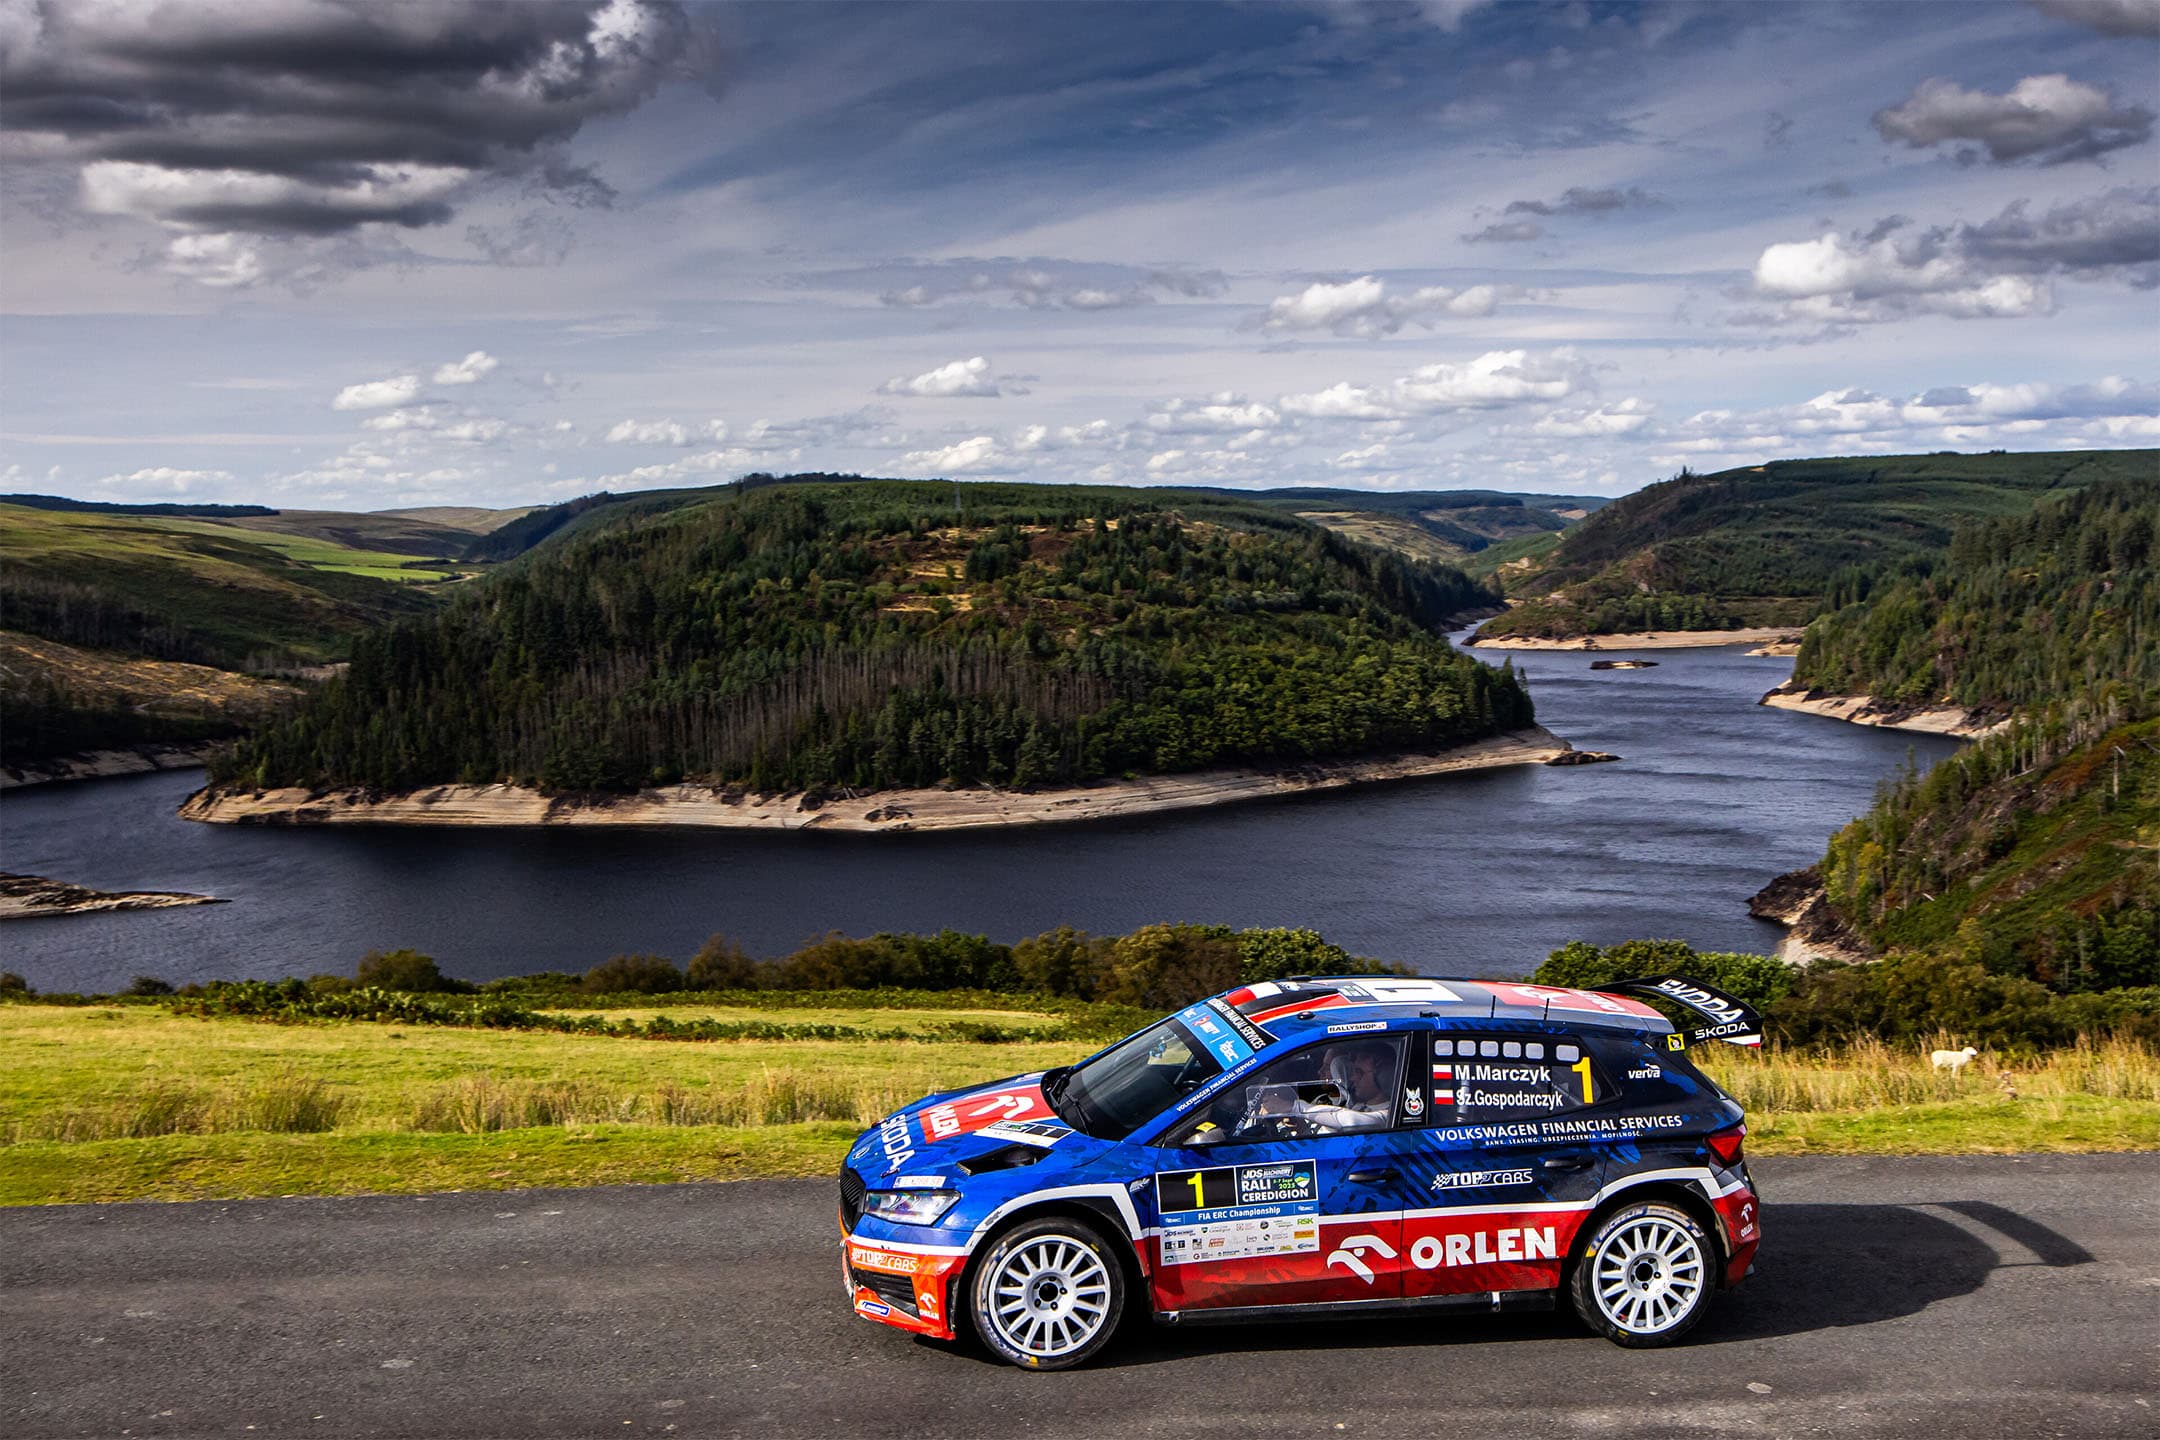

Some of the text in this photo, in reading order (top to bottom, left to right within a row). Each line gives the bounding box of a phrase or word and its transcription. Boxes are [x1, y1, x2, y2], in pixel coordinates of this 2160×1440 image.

[1240, 1025, 1266, 1049] SERVICES
[1455, 1065, 1551, 1086] M.Marczyk
[1572, 1057, 1593, 1104] 1
[1628, 1066, 1660, 1079] verva
[1177, 1087, 1211, 1112] VOLKSWAGEN
[1234, 1057, 1257, 1074] SERVICES
[1456, 1090, 1563, 1111] Sz.Gospodarczyk
[1436, 1115, 1683, 1142] VOLKSWAGEN FINANCIAL SERVICES
[1243, 1169, 1263, 1179] JDS
[1450, 1171, 1533, 1186] TOP CARS
[1187, 1172, 1204, 1208] 1
[1241, 1179, 1271, 1192] RALI
[1242, 1188, 1309, 1202] CEREDIGION
[1198, 1206, 1280, 1220] FIA ERC Championship
[1411, 1227, 1557, 1270] ORLEN
